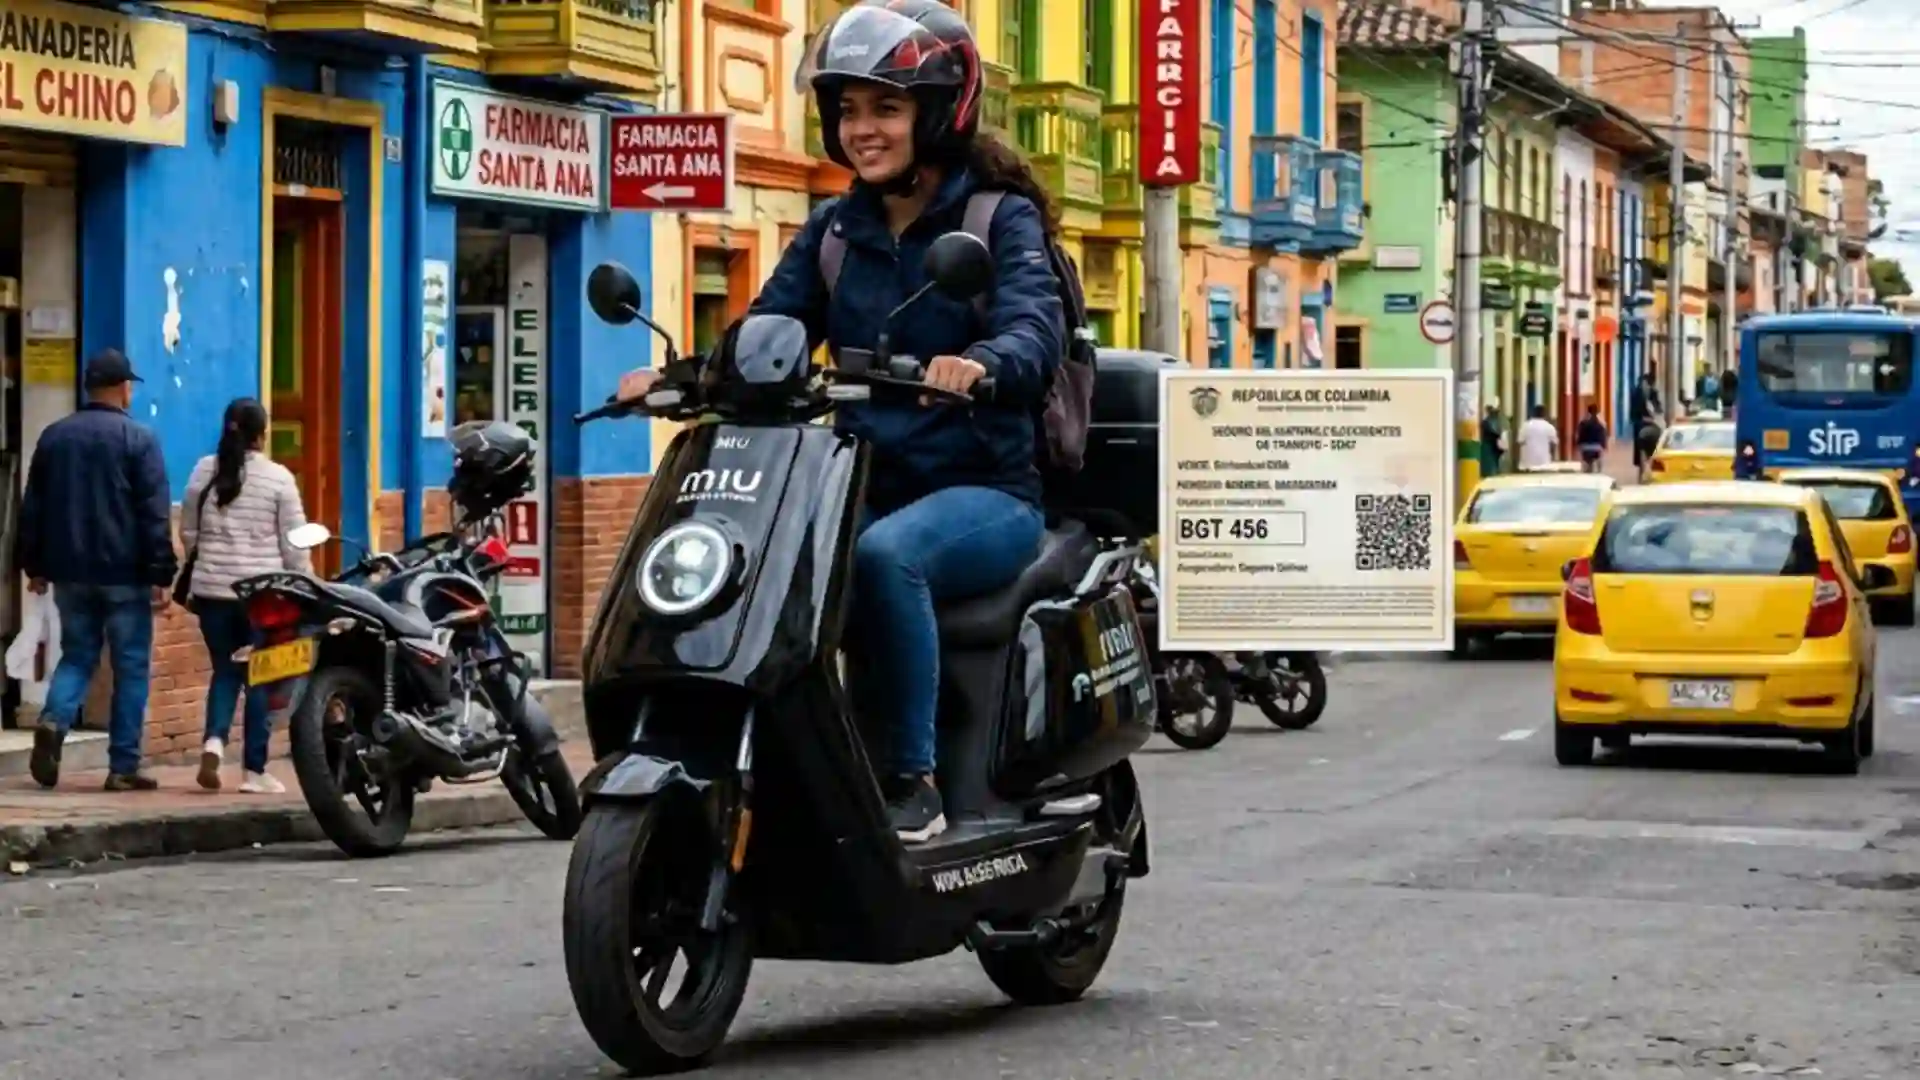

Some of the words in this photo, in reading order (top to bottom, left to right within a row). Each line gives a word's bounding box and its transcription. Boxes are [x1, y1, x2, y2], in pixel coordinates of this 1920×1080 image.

[0, 10, 137, 70] ANADERÍA
[0, 61, 24, 111] L
[35, 67, 137, 125] CHINO
[485, 103, 590, 154] FARMACIA
[618, 123, 719, 148] FARMACIA
[478, 148, 548, 193] SANTA
[553, 159, 595, 198] ANA
[614, 152, 677, 177] SANTA
[681, 152, 723, 177] ANA
[1180, 518, 1223, 539] BGT
[1229, 518, 1269, 539] 456
